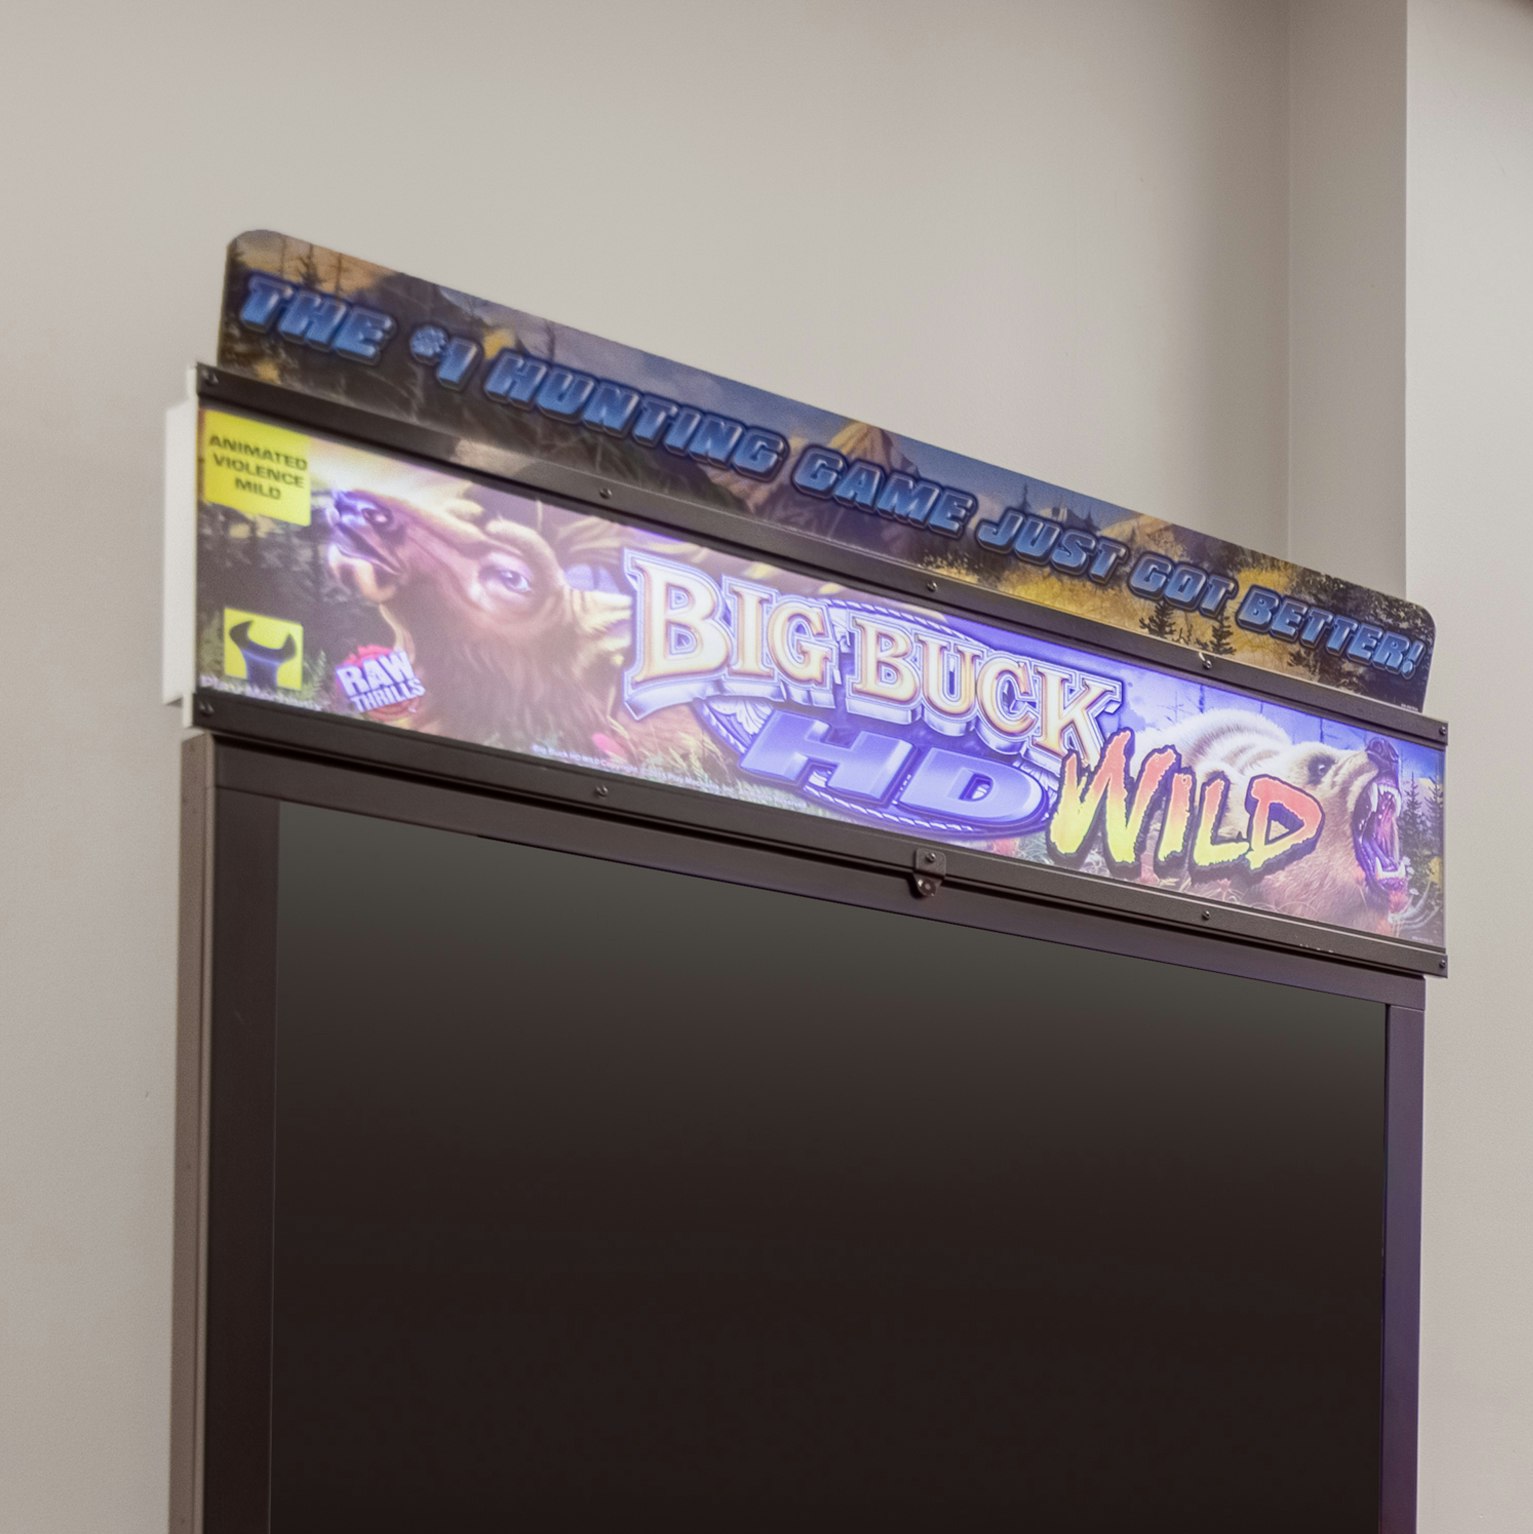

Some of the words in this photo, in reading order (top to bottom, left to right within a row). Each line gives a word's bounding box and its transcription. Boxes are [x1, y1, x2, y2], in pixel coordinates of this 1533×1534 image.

[209, 435, 308, 471] ANIMATED
[212, 453, 304, 488] VIOLENCE
[235, 477, 281, 499] MILD
[241, 275, 396, 363] THE
[485, 349, 790, 482] HUNTING
[792, 446, 977, 536] GAME
[977, 509, 1128, 584] JUST
[1128, 553, 1238, 617] GOT
[1235, 585, 1428, 680] BETTER!
[336, 650, 415, 696] RAW
[624, 549, 840, 712] BIG
[849, 614, 1125, 767] BUCK
[350, 679, 426, 713] THRILLS
[740, 709, 1048, 826] HD
[1048, 729, 1324, 877] WILD
